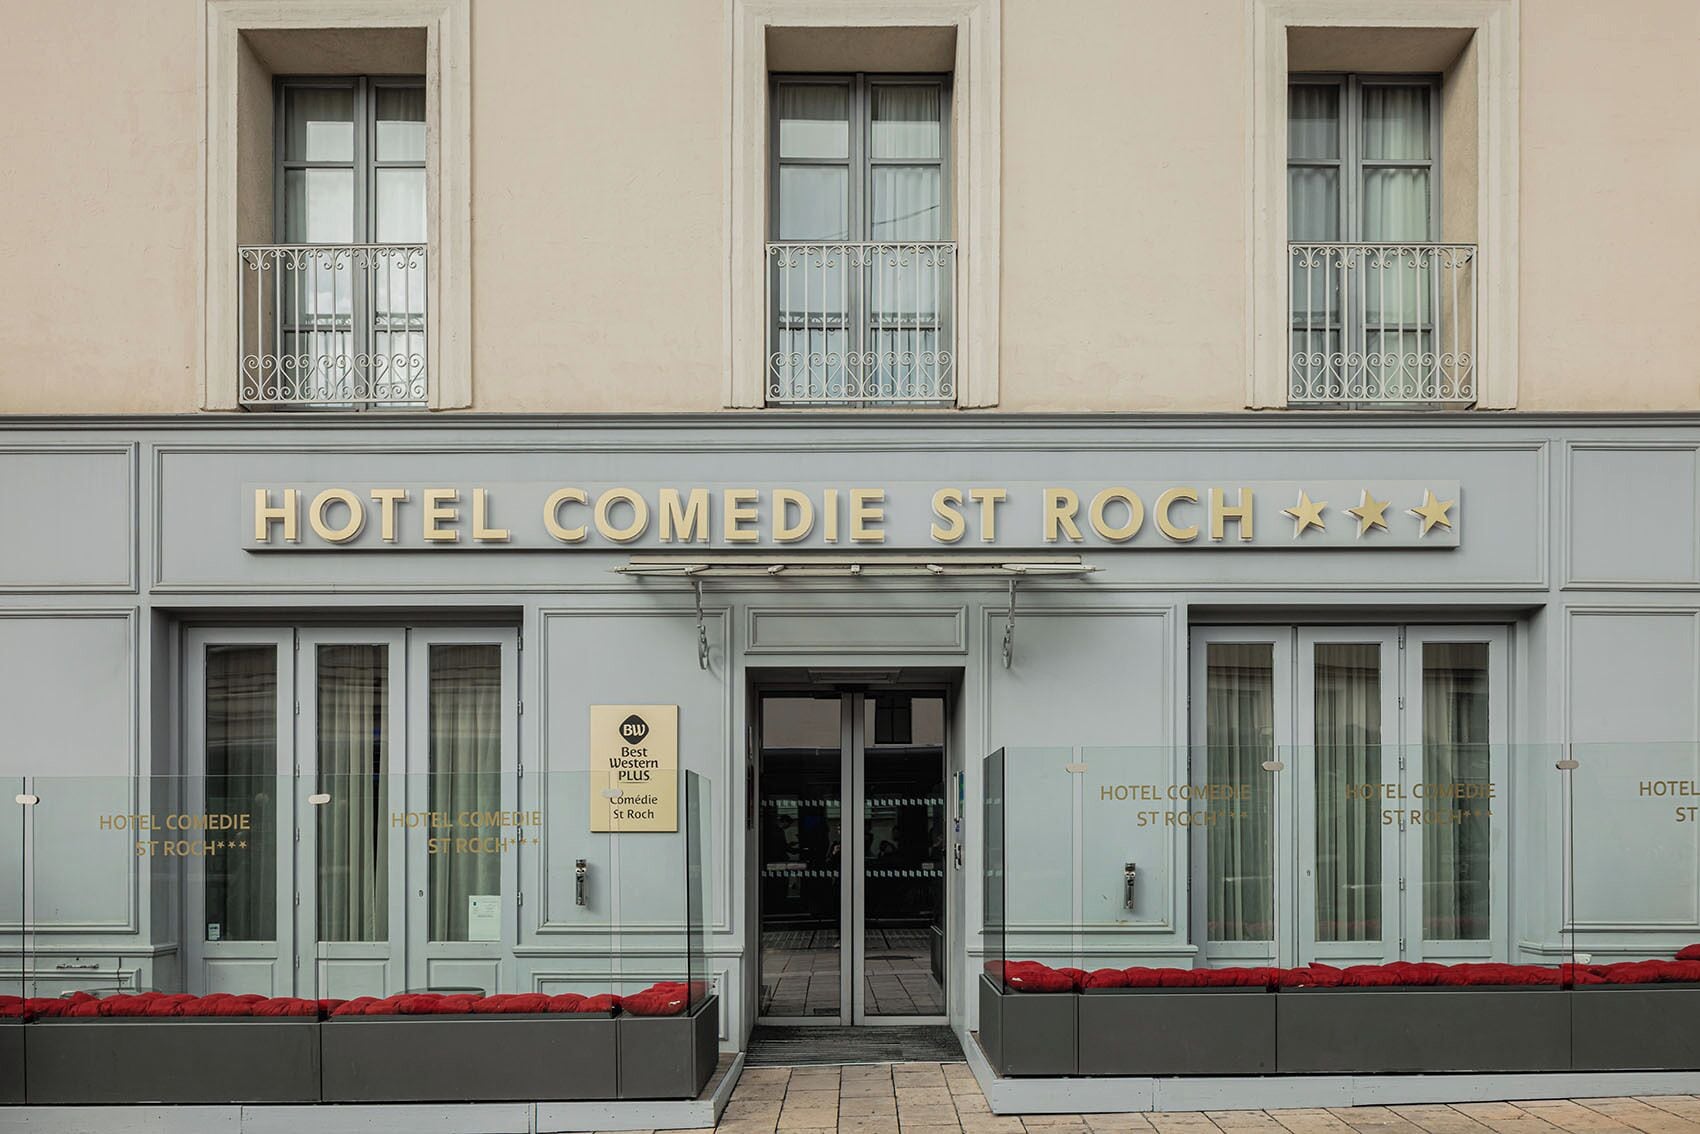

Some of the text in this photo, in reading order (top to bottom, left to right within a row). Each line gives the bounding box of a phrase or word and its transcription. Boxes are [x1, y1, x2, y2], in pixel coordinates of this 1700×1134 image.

[254, 486, 1255, 544] HOTEL COMEDIE ST ROCH
[623, 724, 646, 736] BW
[621, 747, 648, 757] Best
[609, 758, 659, 768] Western
[618, 770, 650, 781] PLUS
[1101, 784, 1251, 800] HOTEL COMEDIE
[1345, 783, 1496, 799] HOTEL COMEDIE
[1640, 780, 1700, 796] HOTEL
[100, 814, 250, 830] HOTEL COMEDIE
[391, 811, 542, 828] HOTEL COMEDIE
[613, 809, 654, 819] St Roch
[1136, 811, 1160, 827] ST
[1382, 810, 1405, 825] ST
[1675, 806, 1699, 822] ST
[136, 841, 159, 856] ST
[428, 838, 451, 854] ST
